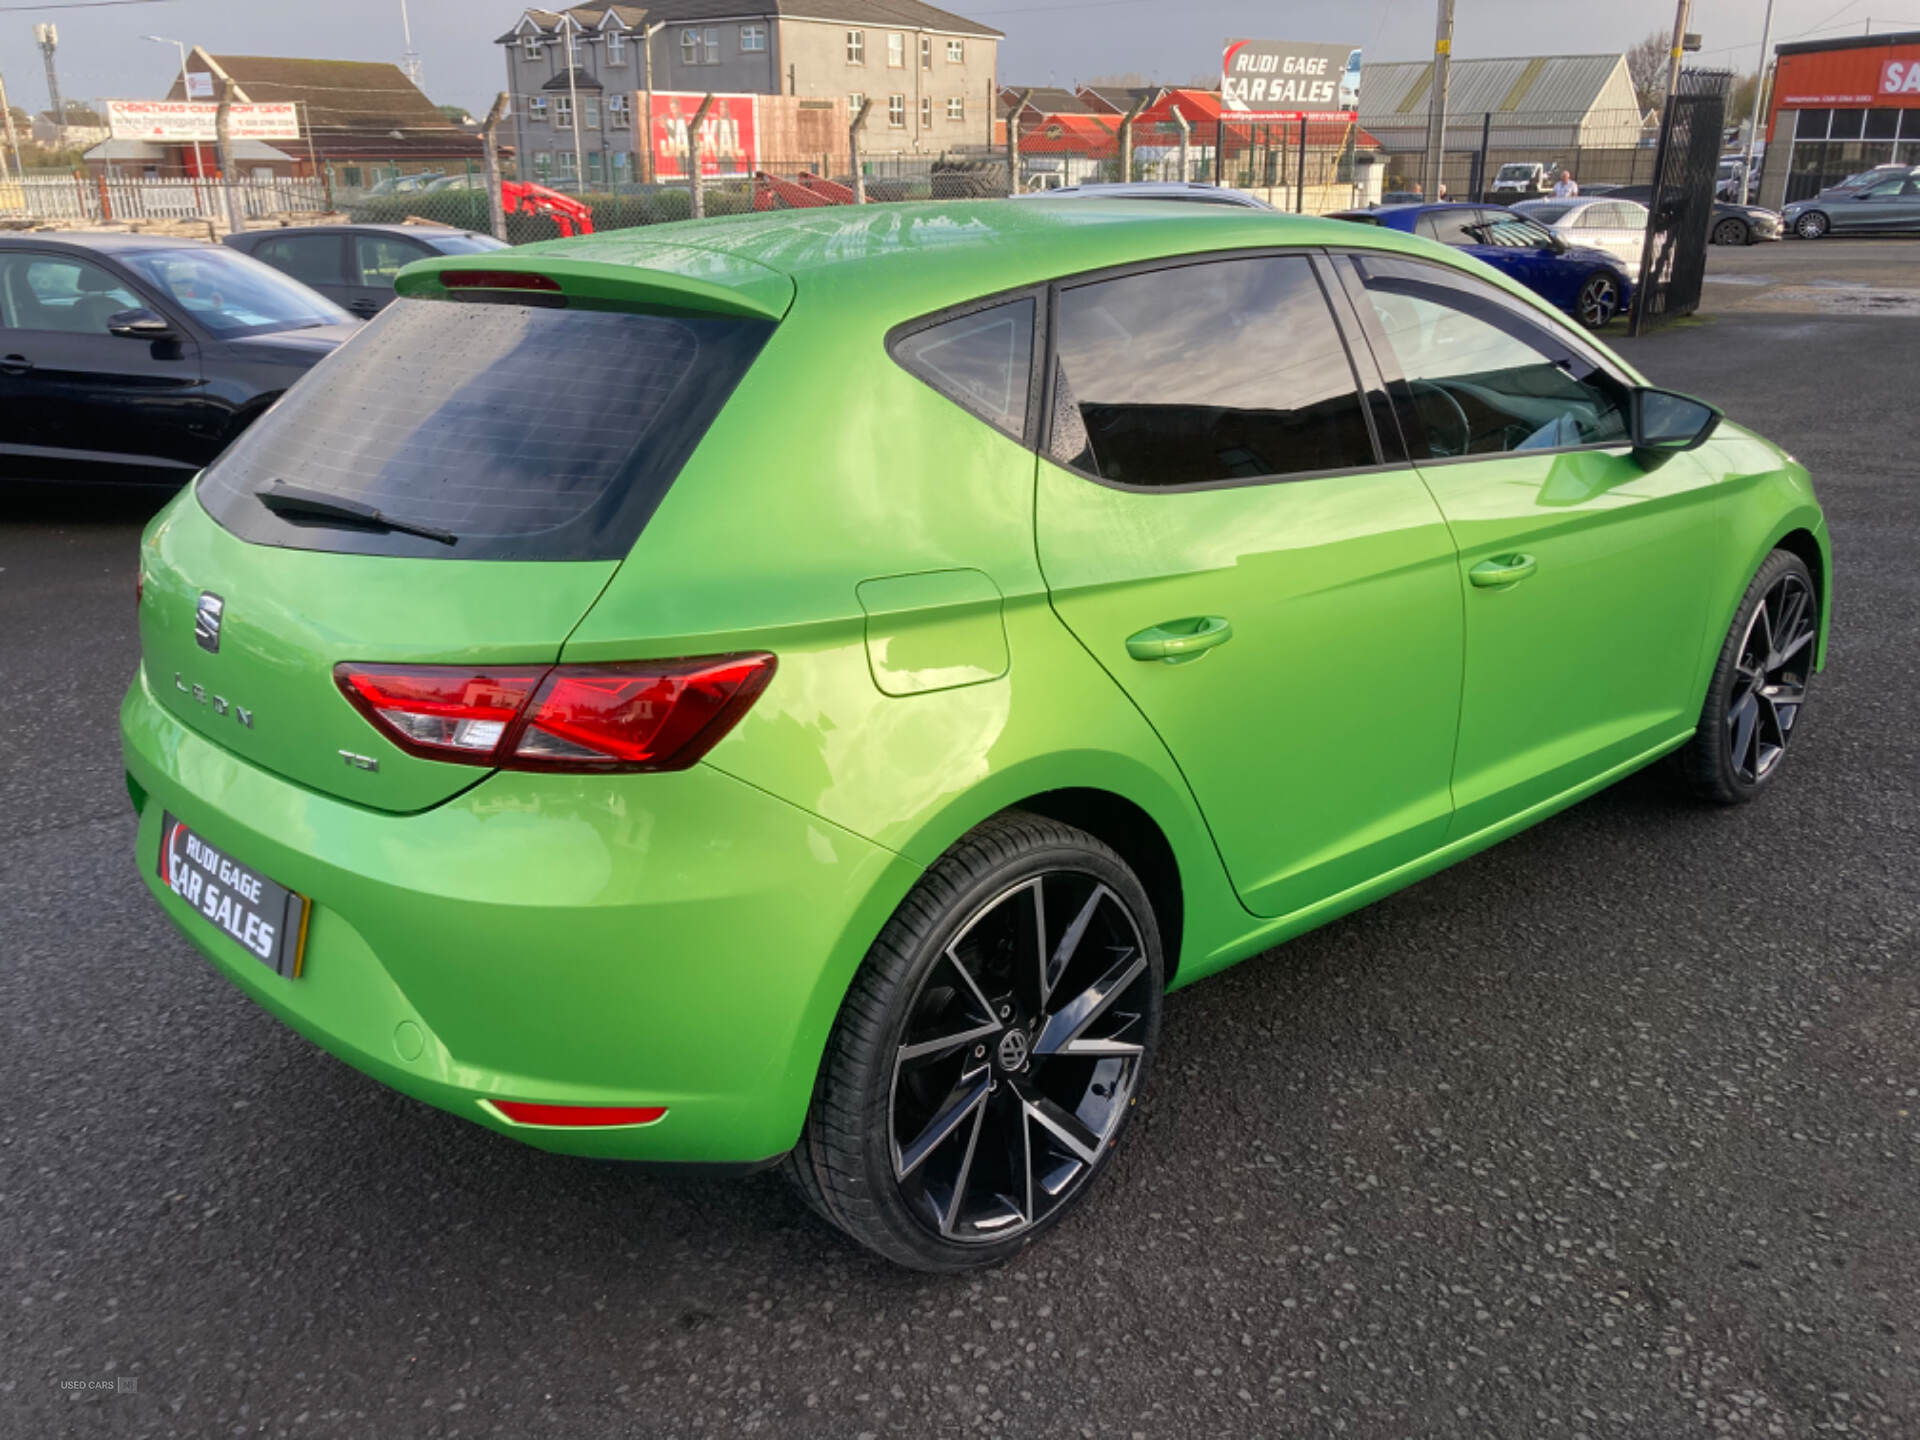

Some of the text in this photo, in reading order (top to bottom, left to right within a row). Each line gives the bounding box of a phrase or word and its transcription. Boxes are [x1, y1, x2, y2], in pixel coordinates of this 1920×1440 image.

[1236, 53, 1328, 75] RUDI GAGE
[1222, 77, 1336, 102] CAR SALES
[175, 672, 254, 729] LEON
[338, 749, 379, 773] TDI
[186, 833, 262, 904] RUDI GAGE
[170, 853, 275, 958] CAR SALES
